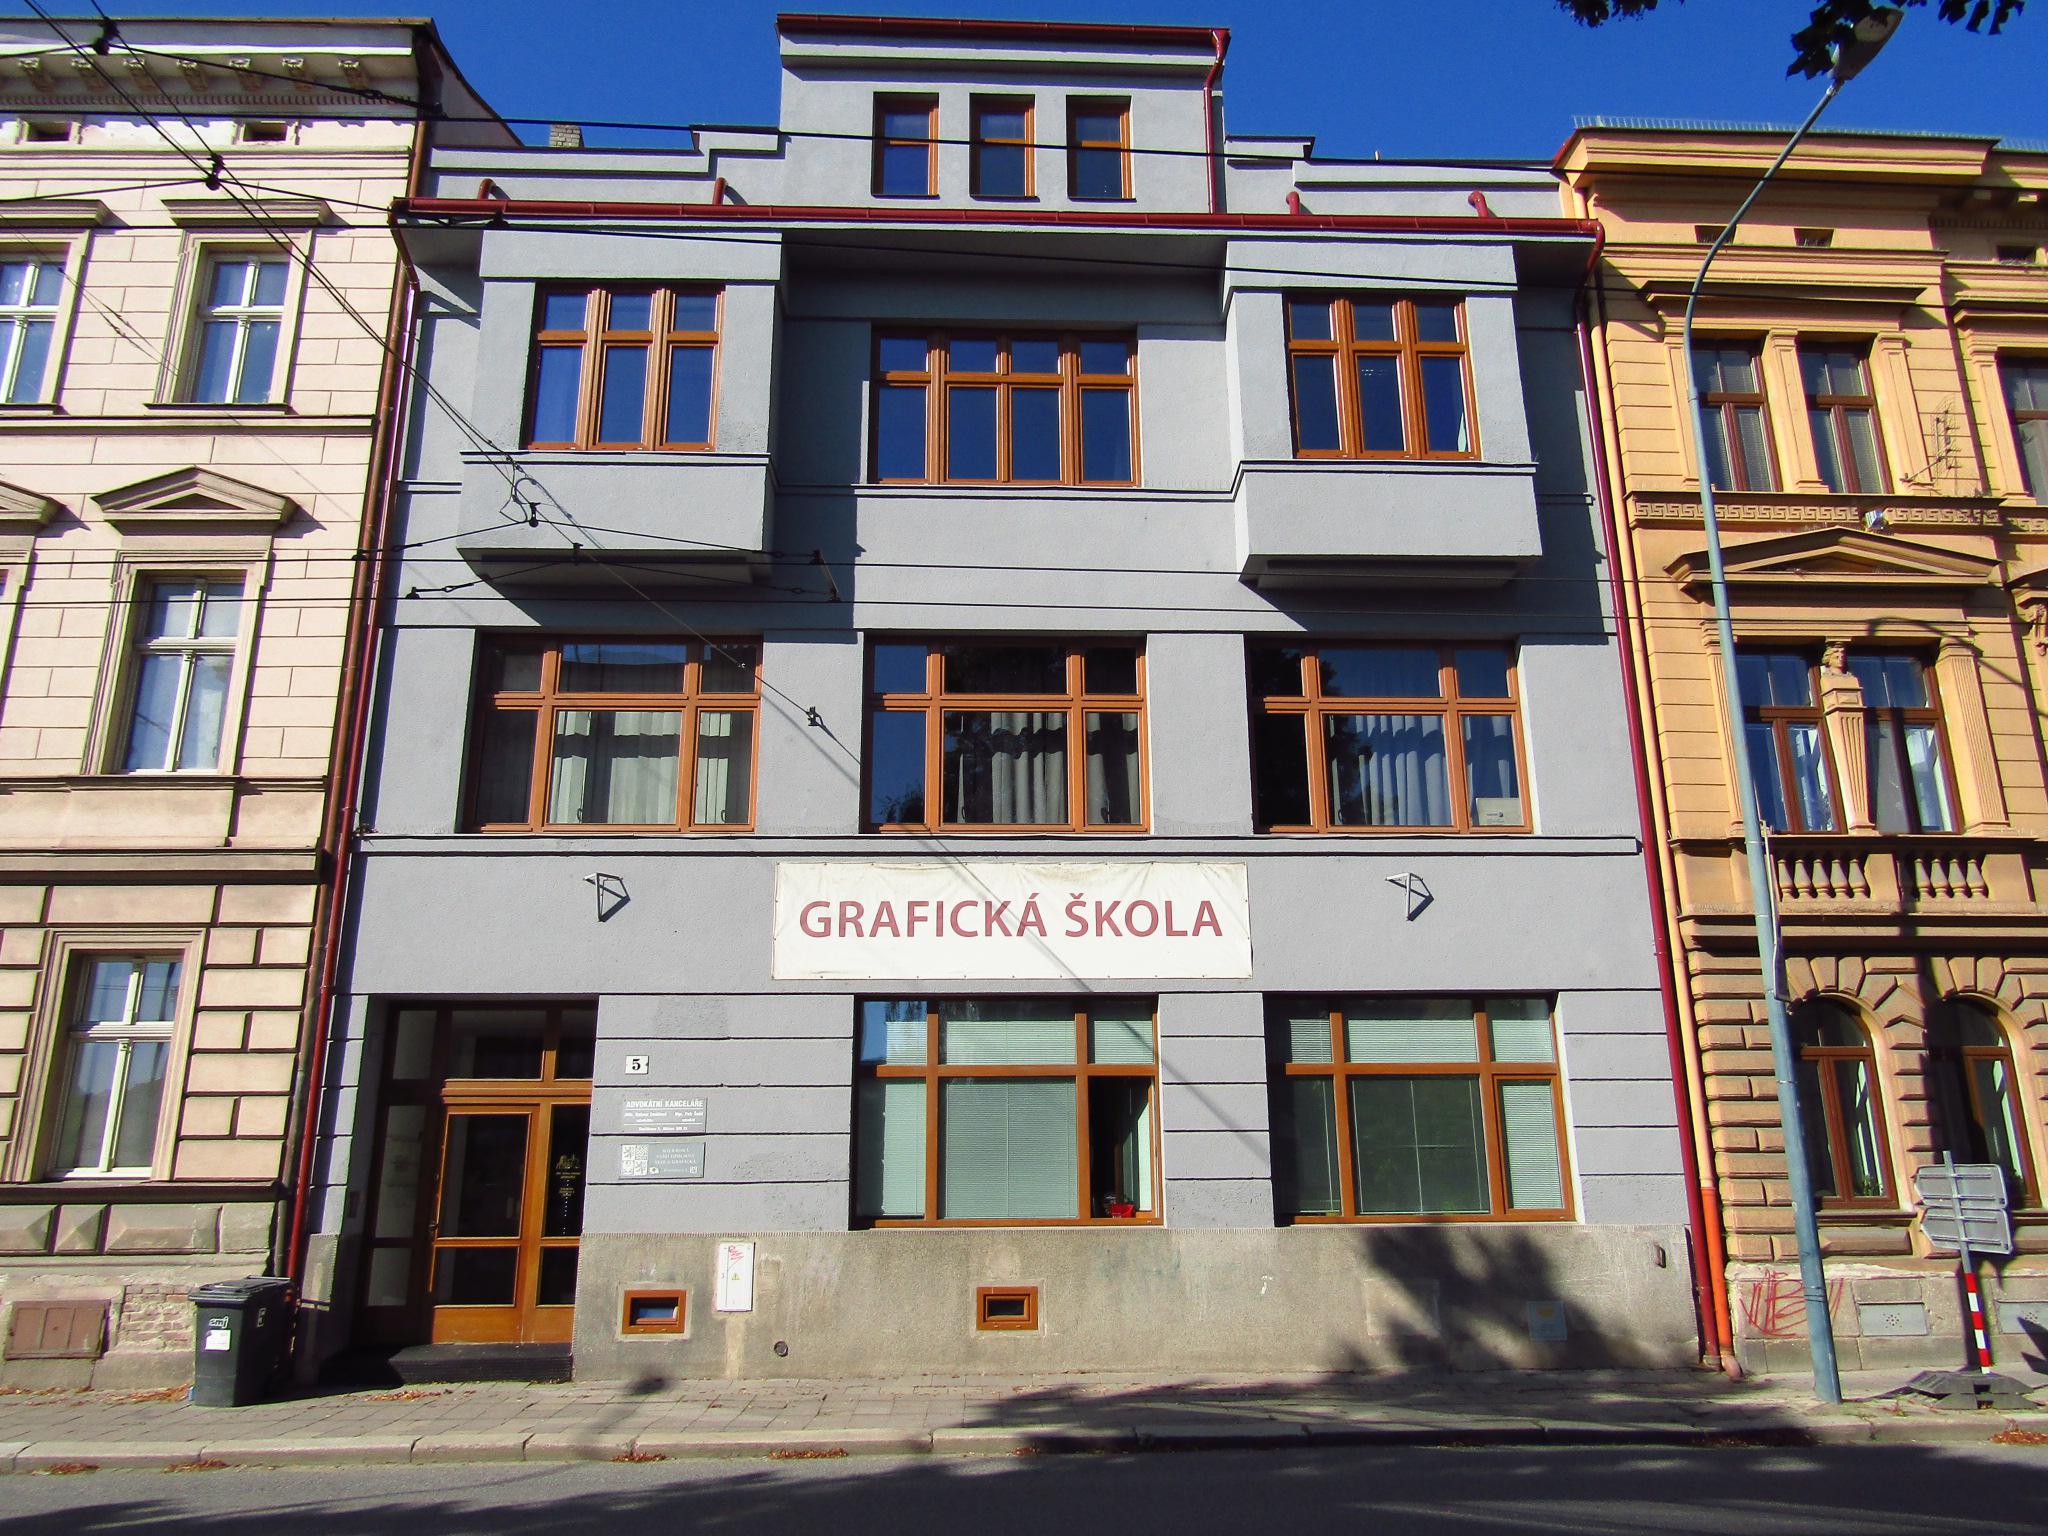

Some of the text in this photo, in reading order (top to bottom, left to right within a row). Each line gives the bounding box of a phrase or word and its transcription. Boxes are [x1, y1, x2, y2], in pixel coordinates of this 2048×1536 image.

[799, 892, 1223, 938] GRAFICKÁ ŠKOLA
[631, 1058, 641, 1071] 5
[626, 1098, 704, 1108] ADVOKÁTNÍ KANCELÁŘE
